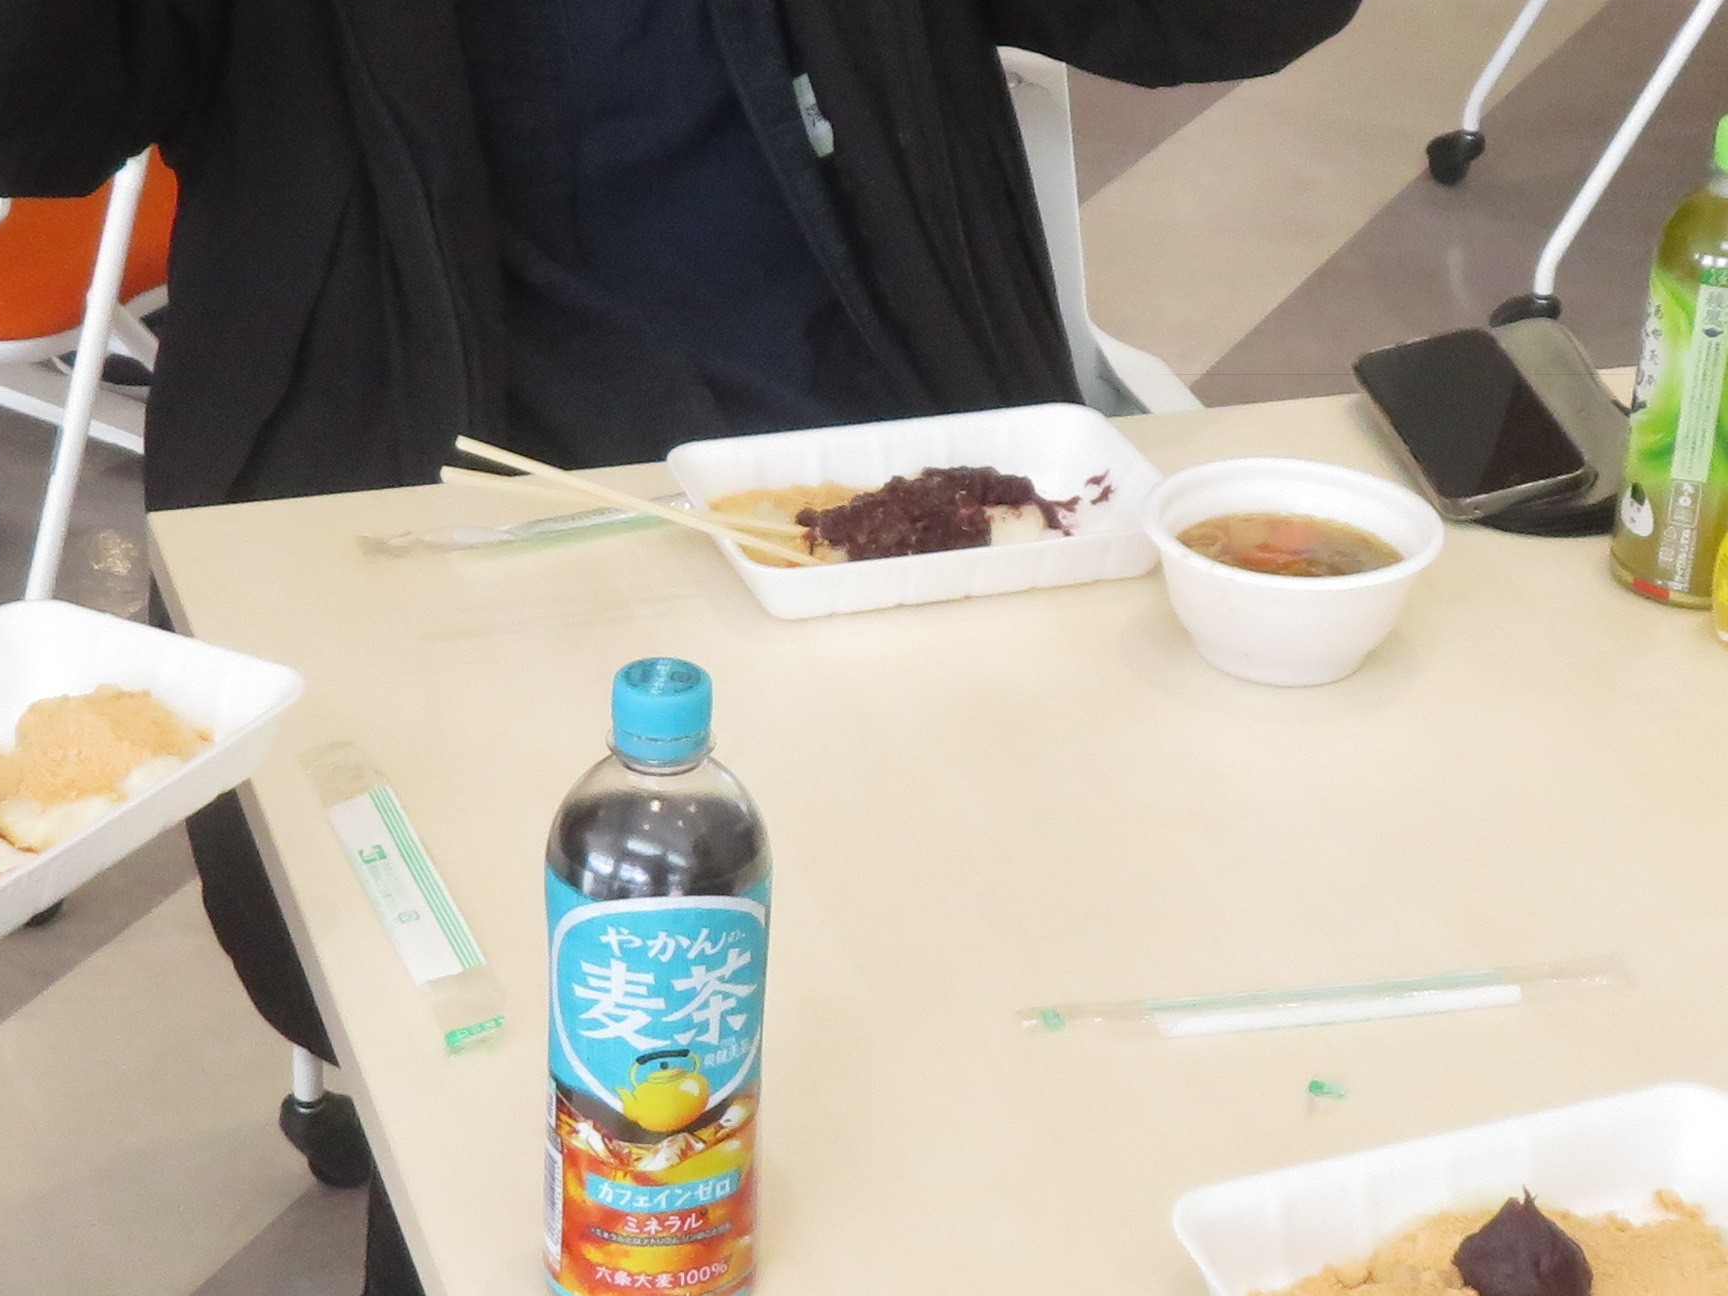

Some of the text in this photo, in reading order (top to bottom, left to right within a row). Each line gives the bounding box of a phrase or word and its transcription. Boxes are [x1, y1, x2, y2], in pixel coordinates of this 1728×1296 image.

[572, 947, 758, 1051] 麦茶
[598, 1177, 733, 1209] カフェインゼロ
